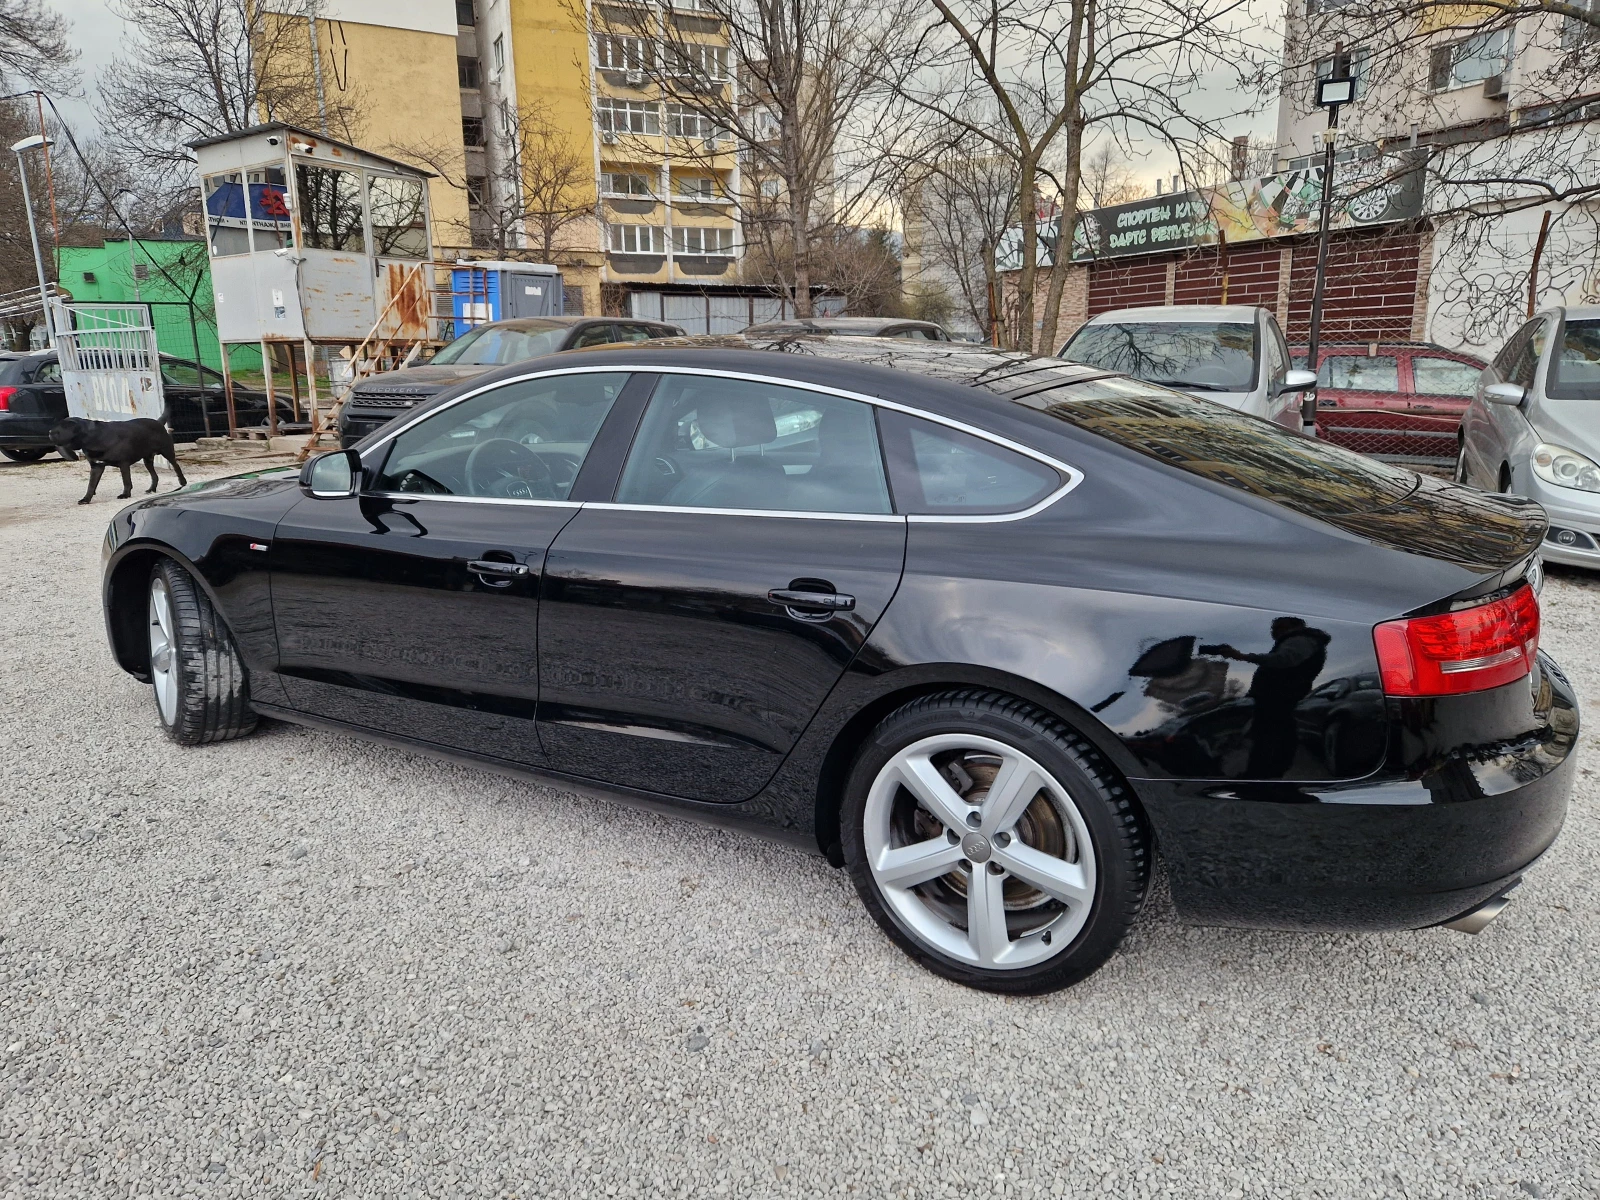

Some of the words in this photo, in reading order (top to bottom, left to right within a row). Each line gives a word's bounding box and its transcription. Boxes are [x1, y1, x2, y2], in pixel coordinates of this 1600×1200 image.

[1116, 204, 1171, 228] СПОРТЕН
[1109, 229, 1146, 249] ДАРТС
[91, 376, 133, 415] ВХОД
